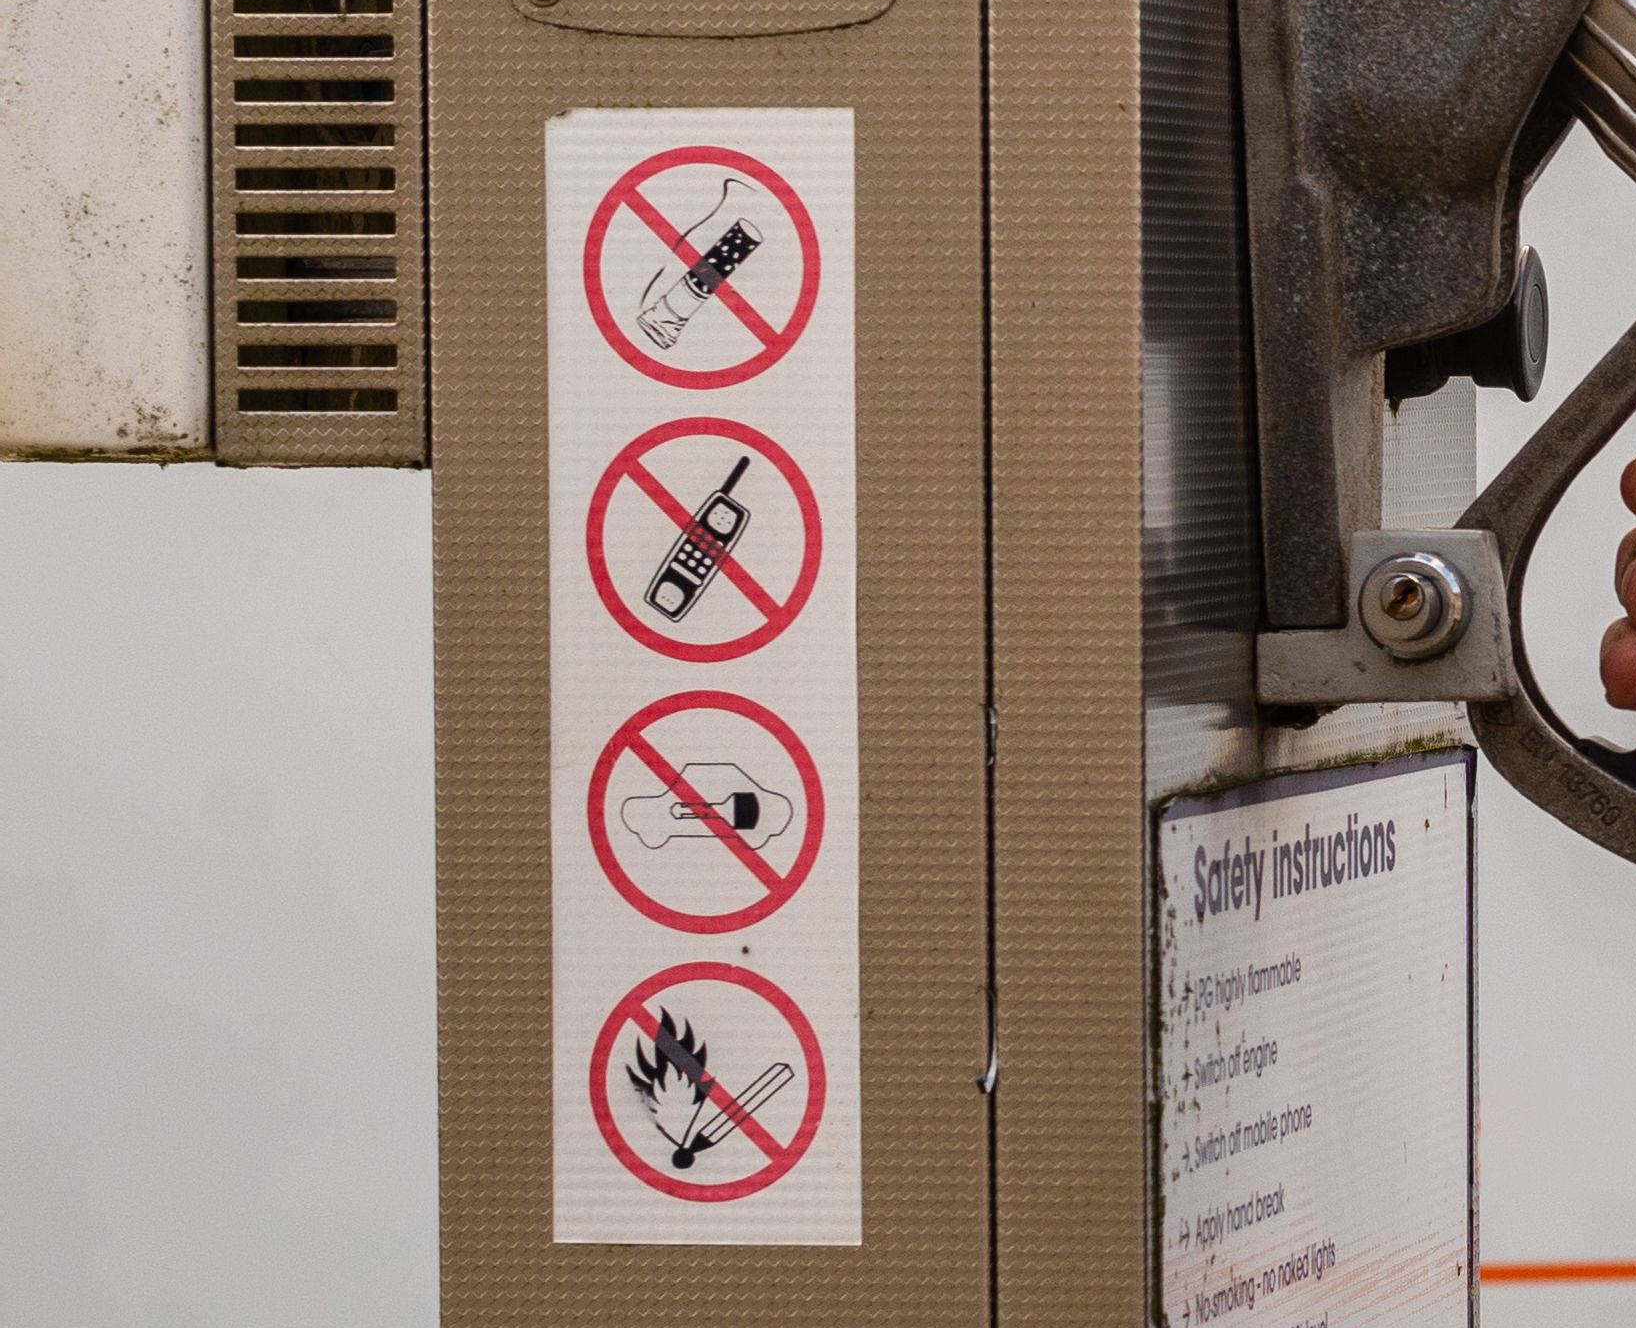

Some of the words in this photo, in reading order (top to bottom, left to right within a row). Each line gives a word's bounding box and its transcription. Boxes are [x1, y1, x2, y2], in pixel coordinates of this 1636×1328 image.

[1557, 762, 1622, 827] 13760
[1194, 835, 1265, 921] Safety
[1273, 812, 1396, 900] instructions
[1194, 975, 1213, 1012] LPG
[1215, 967, 1246, 1011] highly
[1248, 952, 1301, 997] flammable
[1194, 1049, 1226, 1090] Switch
[1228, 1043, 1241, 1079] off
[1243, 1036, 1278, 1078] engine
[1195, 1127, 1226, 1169] Switch
[1228, 1120, 1242, 1156] off
[1243, 1110, 1278, 1151] mobile
[1280, 1103, 1312, 1145] phone
[1195, 1206, 1225, 1249] Apply
[1226, 1192, 1253, 1234] hand
[1255, 1182, 1285, 1222] break
[1262, 1268, 1276, 1297] no
[1278, 1245, 1309, 1290] naked
[1311, 1237, 1336, 1281] lights
